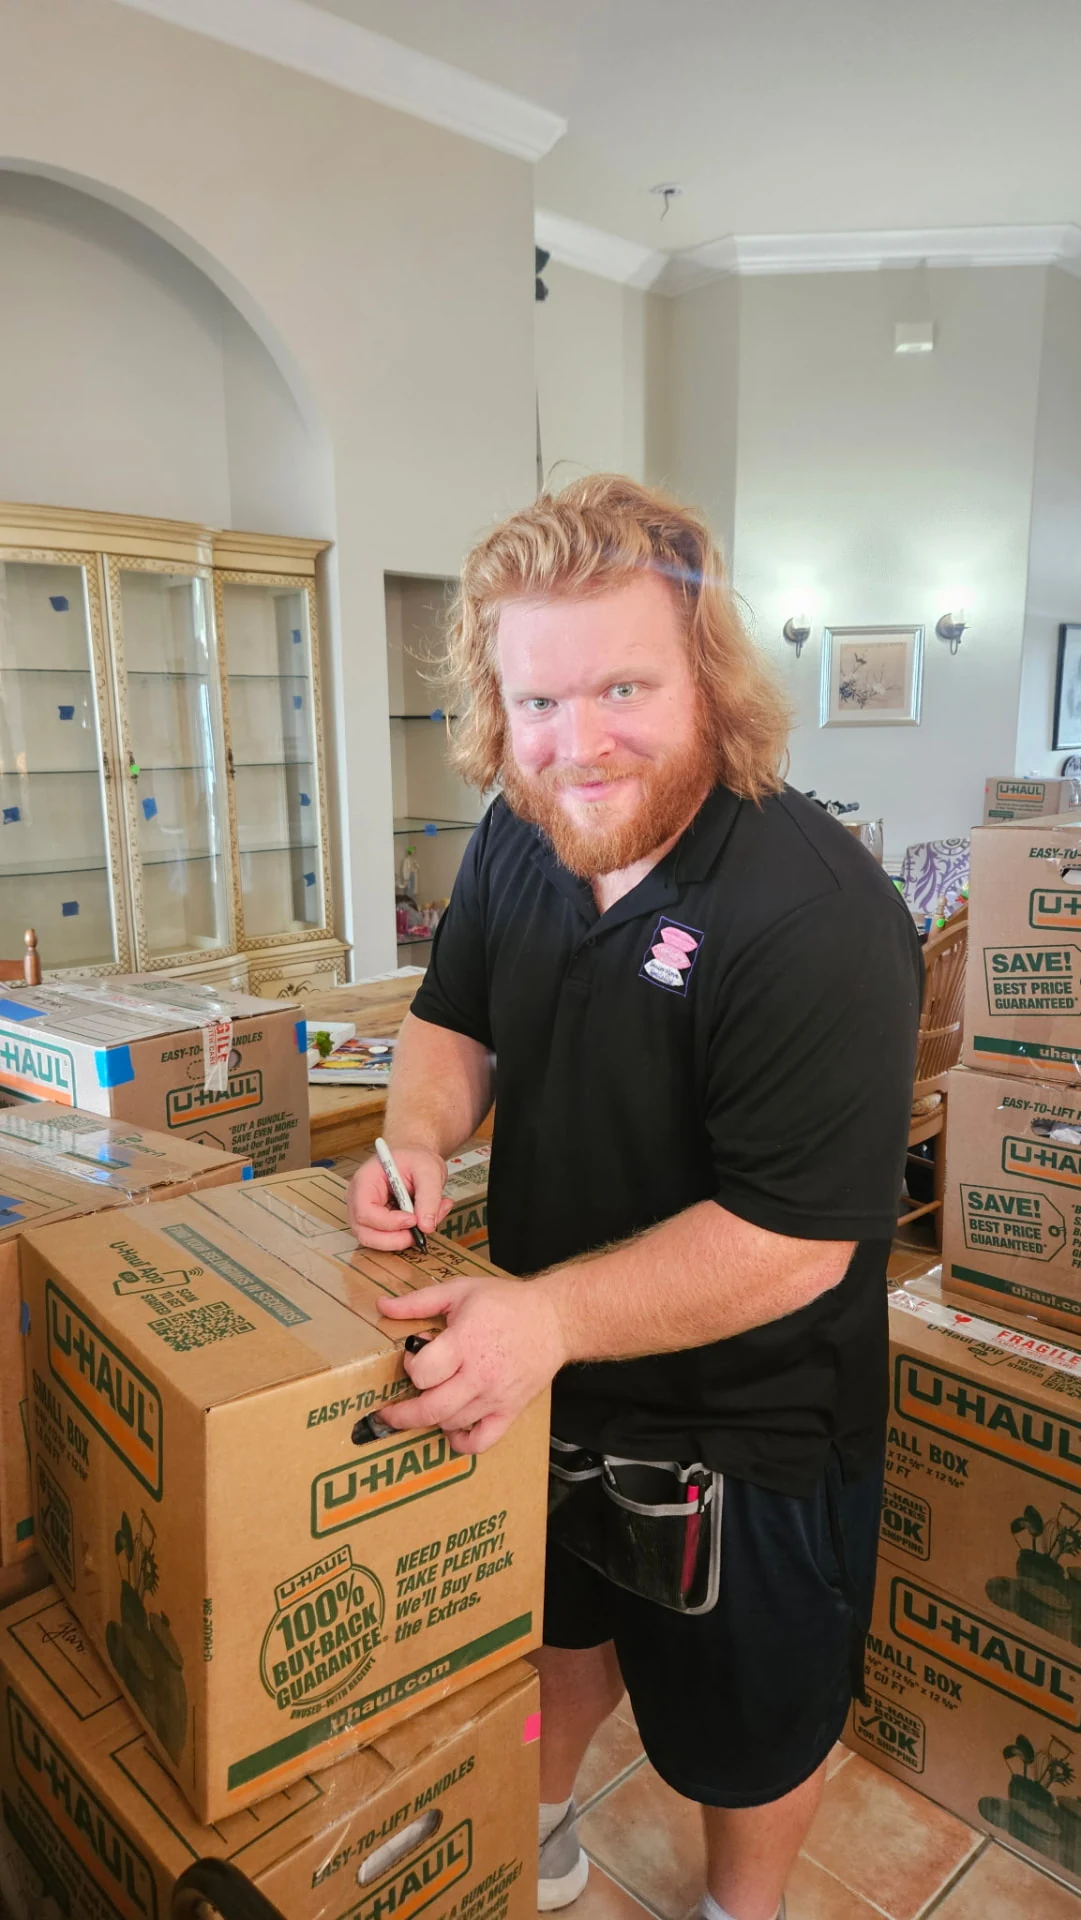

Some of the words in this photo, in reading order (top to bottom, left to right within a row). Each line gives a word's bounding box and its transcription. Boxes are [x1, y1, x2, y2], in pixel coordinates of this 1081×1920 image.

[1000, 784, 1042, 796] U-HAUL
[992, 952, 1072, 973] SAVE!
[993, 982, 1026, 995] BEST
[1031, 981, 1072, 995] PRICE
[160, 1045, 203, 1063] EASY-TO-
[215, 1022, 230, 1063] GILE
[231, 1031, 263, 1046] ANDLES
[0, 1044, 69, 1089] -HAUL
[173, 1078, 257, 1113] U-HAUL
[1002, 1096, 1075, 1119] EASY-TO-LIFT
[232, 1132, 252, 1146] SAVE
[253, 1126, 273, 1139] EVEN
[248, 1120, 255, 1130] A
[967, 1191, 1041, 1219] SAVE!
[969, 1218, 1000, 1234] BEST
[1003, 1222, 1042, 1241] PRICE
[137, 1267, 165, 1285] App
[175, 1288, 200, 1303] SCAN
[140, 1293, 172, 1316] STARTED
[996, 1330, 1081, 1367] FRAGILE
[53, 1300, 155, 1453] U-HAUL
[907, 1366, 1081, 1466] U-HAUL
[887, 1426, 923, 1457] ALL
[929, 1441, 970, 1479] BOX
[896, 1464, 911, 1479] FT
[395, 1541, 441, 1577] NEED
[445, 1510, 508, 1554] BOXES?
[881, 1526, 924, 1555] SHIPPING
[882, 1508, 925, 1545] OK
[279, 1553, 348, 1600] U-HAUL
[396, 1566, 436, 1598] TAKE
[441, 1533, 506, 1583] PLENTY!
[395, 1586, 437, 1622] We'll
[440, 1573, 472, 1608] Buy
[475, 1550, 514, 1580] Back
[276, 1573, 365, 1652] 100%
[394, 1616, 423, 1645] the
[426, 1590, 482, 1629] Extras.
[272, 1601, 378, 1689] BUY-BACK
[903, 1589, 1075, 1705] U-HAUL
[276, 1626, 382, 1711] GUARANTEE
[349, 1656, 377, 1692] RECEIPT
[864, 1634, 917, 1677] MALL
[924, 1663, 964, 1702] BOX
[873, 1670, 889, 1686] CU
[890, 1680, 906, 1696] FT
[330, 1660, 451, 1737] uhaul.com
[857, 1726, 875, 1741] FOR
[876, 1737, 919, 1769] SHIPPING
[878, 1720, 919, 1759] OK
[15, 1706, 147, 1918] U-HAUL
[310, 1806, 411, 1890] EASY-TO-LIFT
[413, 1755, 476, 1810] HANDLES
[353, 1838, 464, 1920] -HAUL
